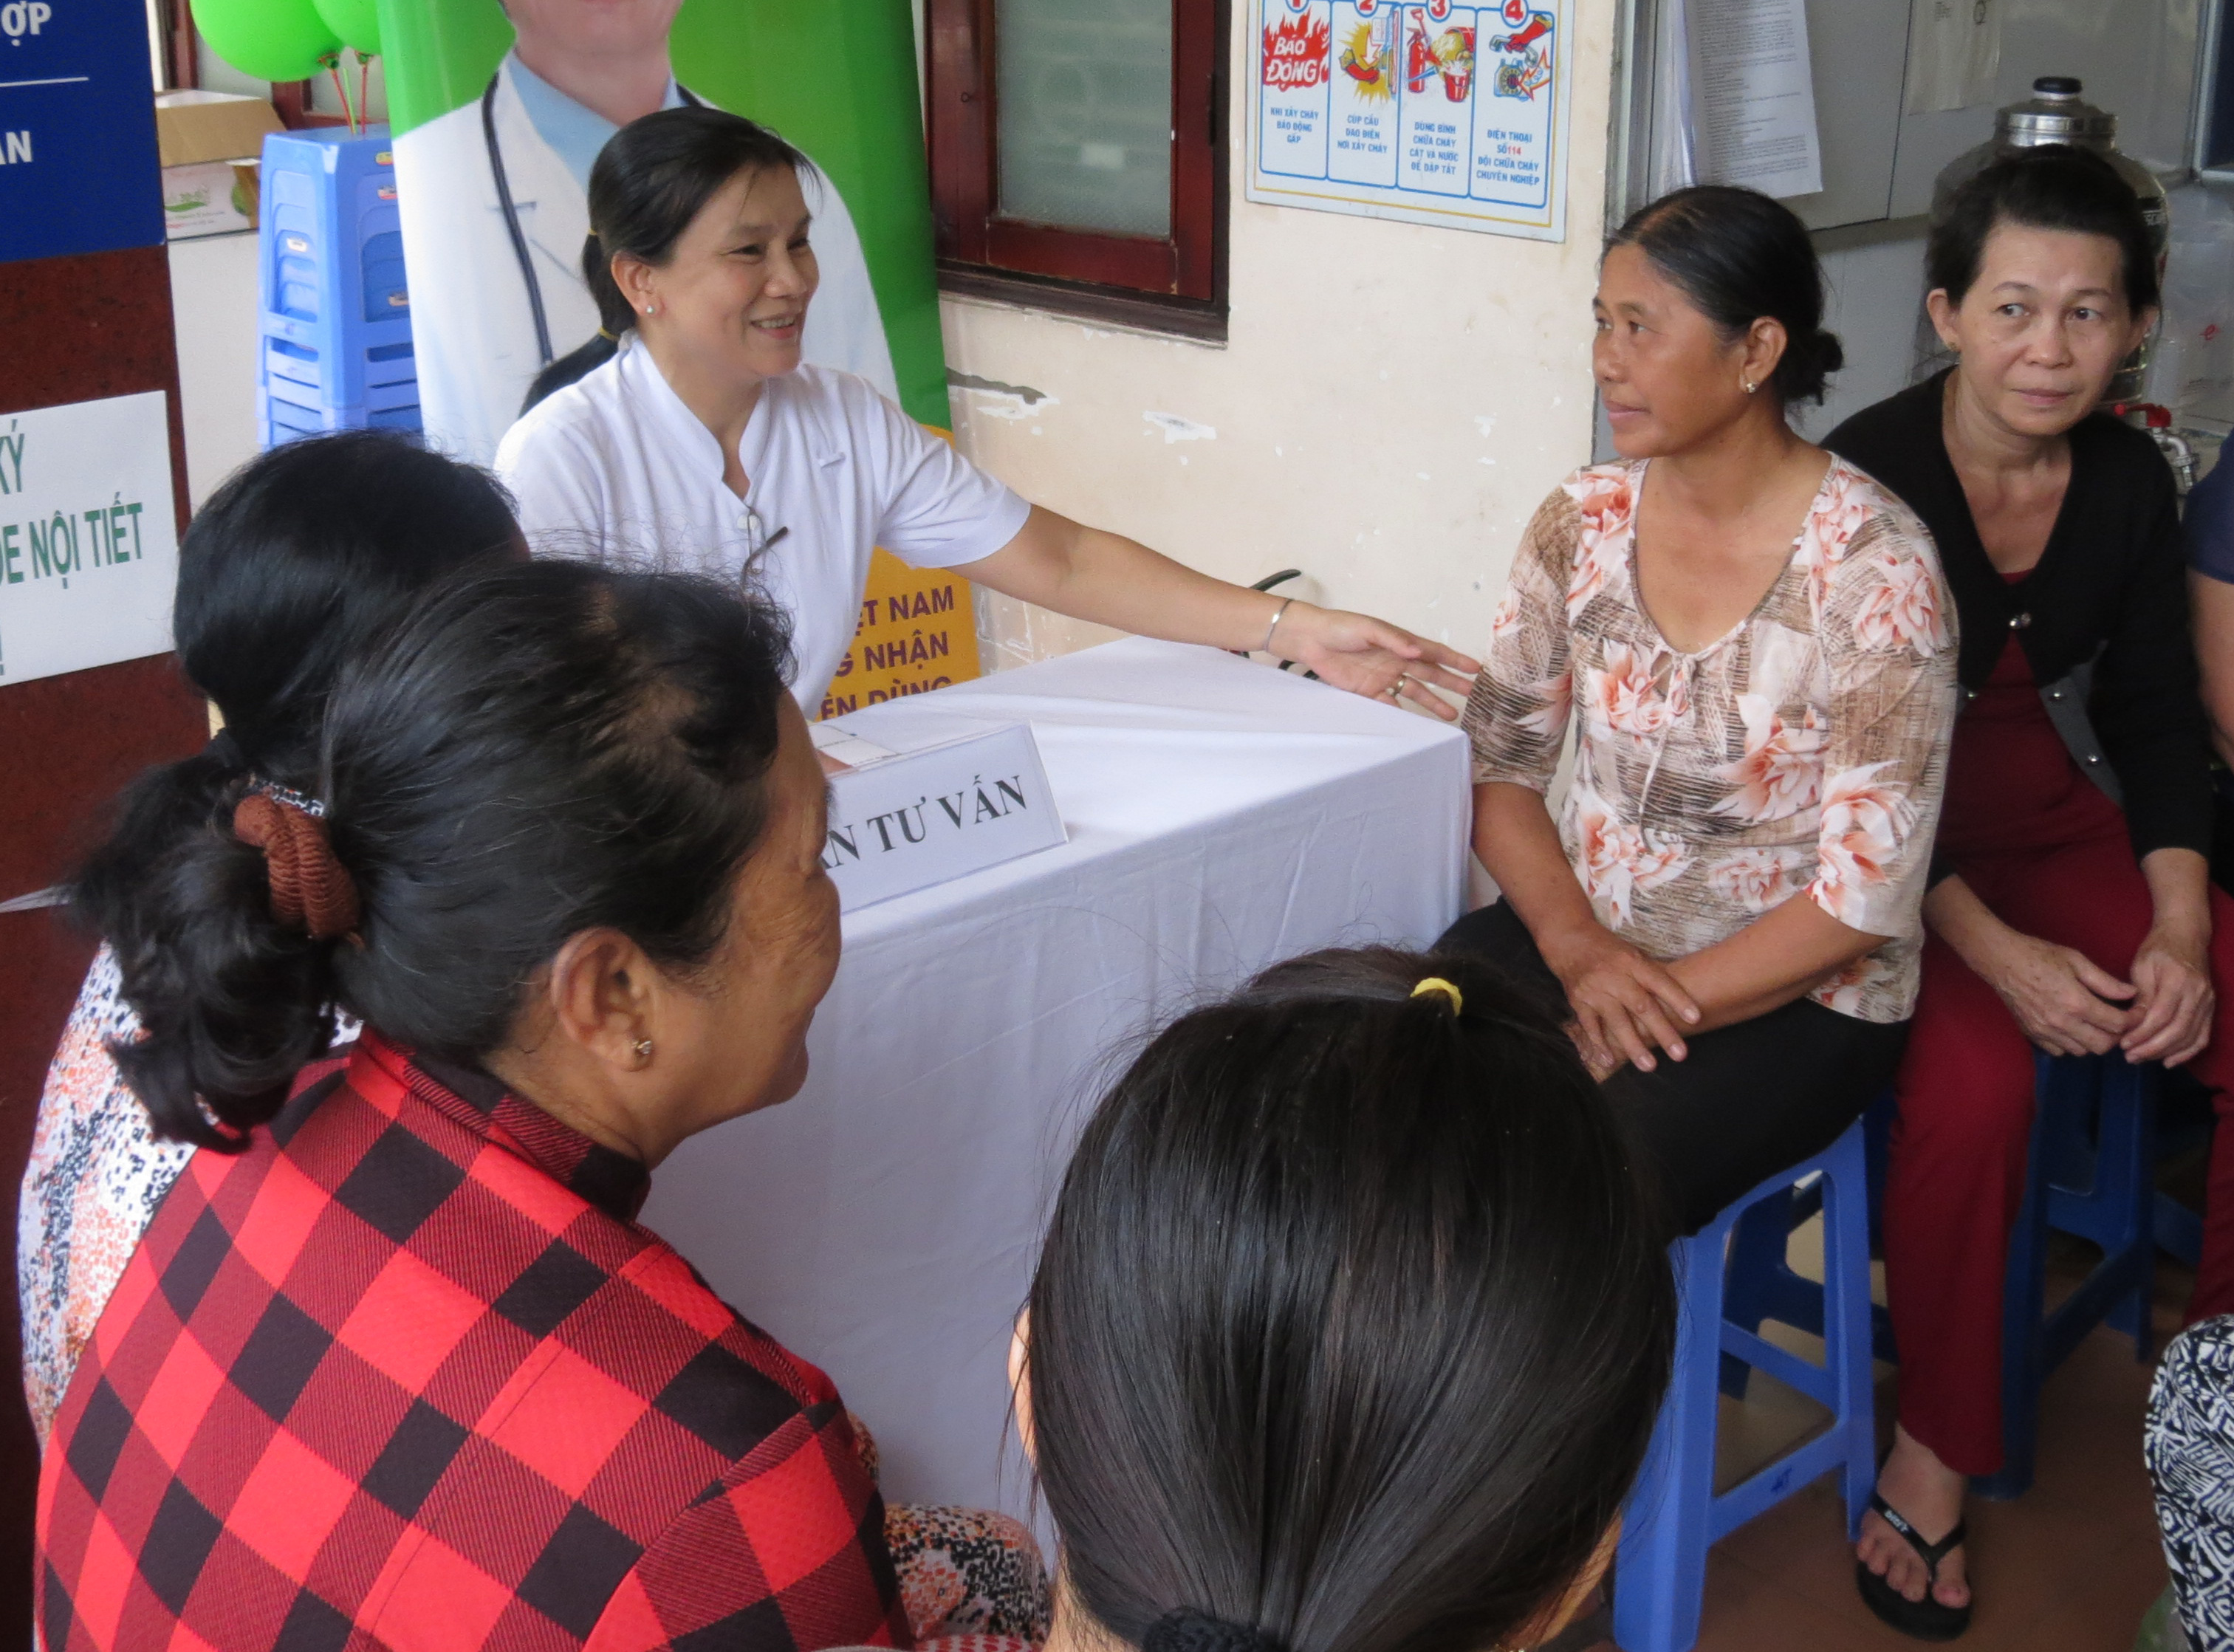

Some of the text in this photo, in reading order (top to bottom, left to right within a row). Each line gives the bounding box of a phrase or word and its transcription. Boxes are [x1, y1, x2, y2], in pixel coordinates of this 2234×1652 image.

[1430, 0, 1447, 17] 3
[1504, 0, 1524, 21] 4
[1266, 58, 1318, 89] ĐỘNG
[1270, 107, 1283, 116] KHI
[1346, 128, 1360, 137] DAO
[1509, 131, 1532, 143] THOẠI
[0, 130, 32, 165] N
[1518, 160, 1539, 171] CHÁY
[0, 491, 143, 589] E NỘI TIẾT
[888, 585, 954, 623] NAM
[864, 628, 949, 671] NHẬN
[866, 796, 926, 853] TƯ
[936, 774, 1027, 830] VẤN
